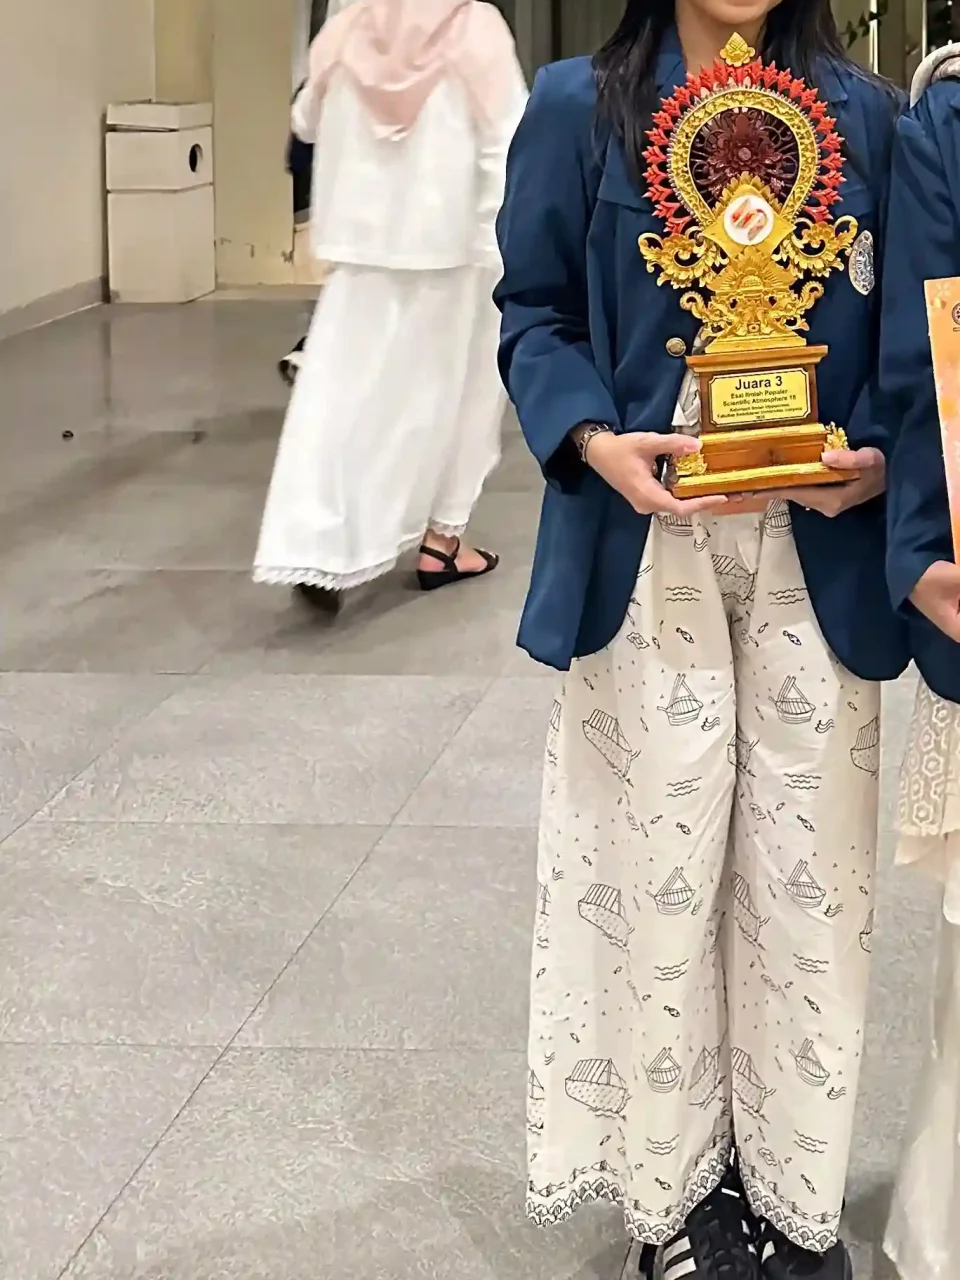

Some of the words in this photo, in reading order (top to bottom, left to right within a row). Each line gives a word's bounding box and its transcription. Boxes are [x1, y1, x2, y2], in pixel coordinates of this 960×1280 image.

[735, 378, 771, 391] Juara
[775, 375, 783, 387] 3
[752, 395, 788, 404] Atmosphere
